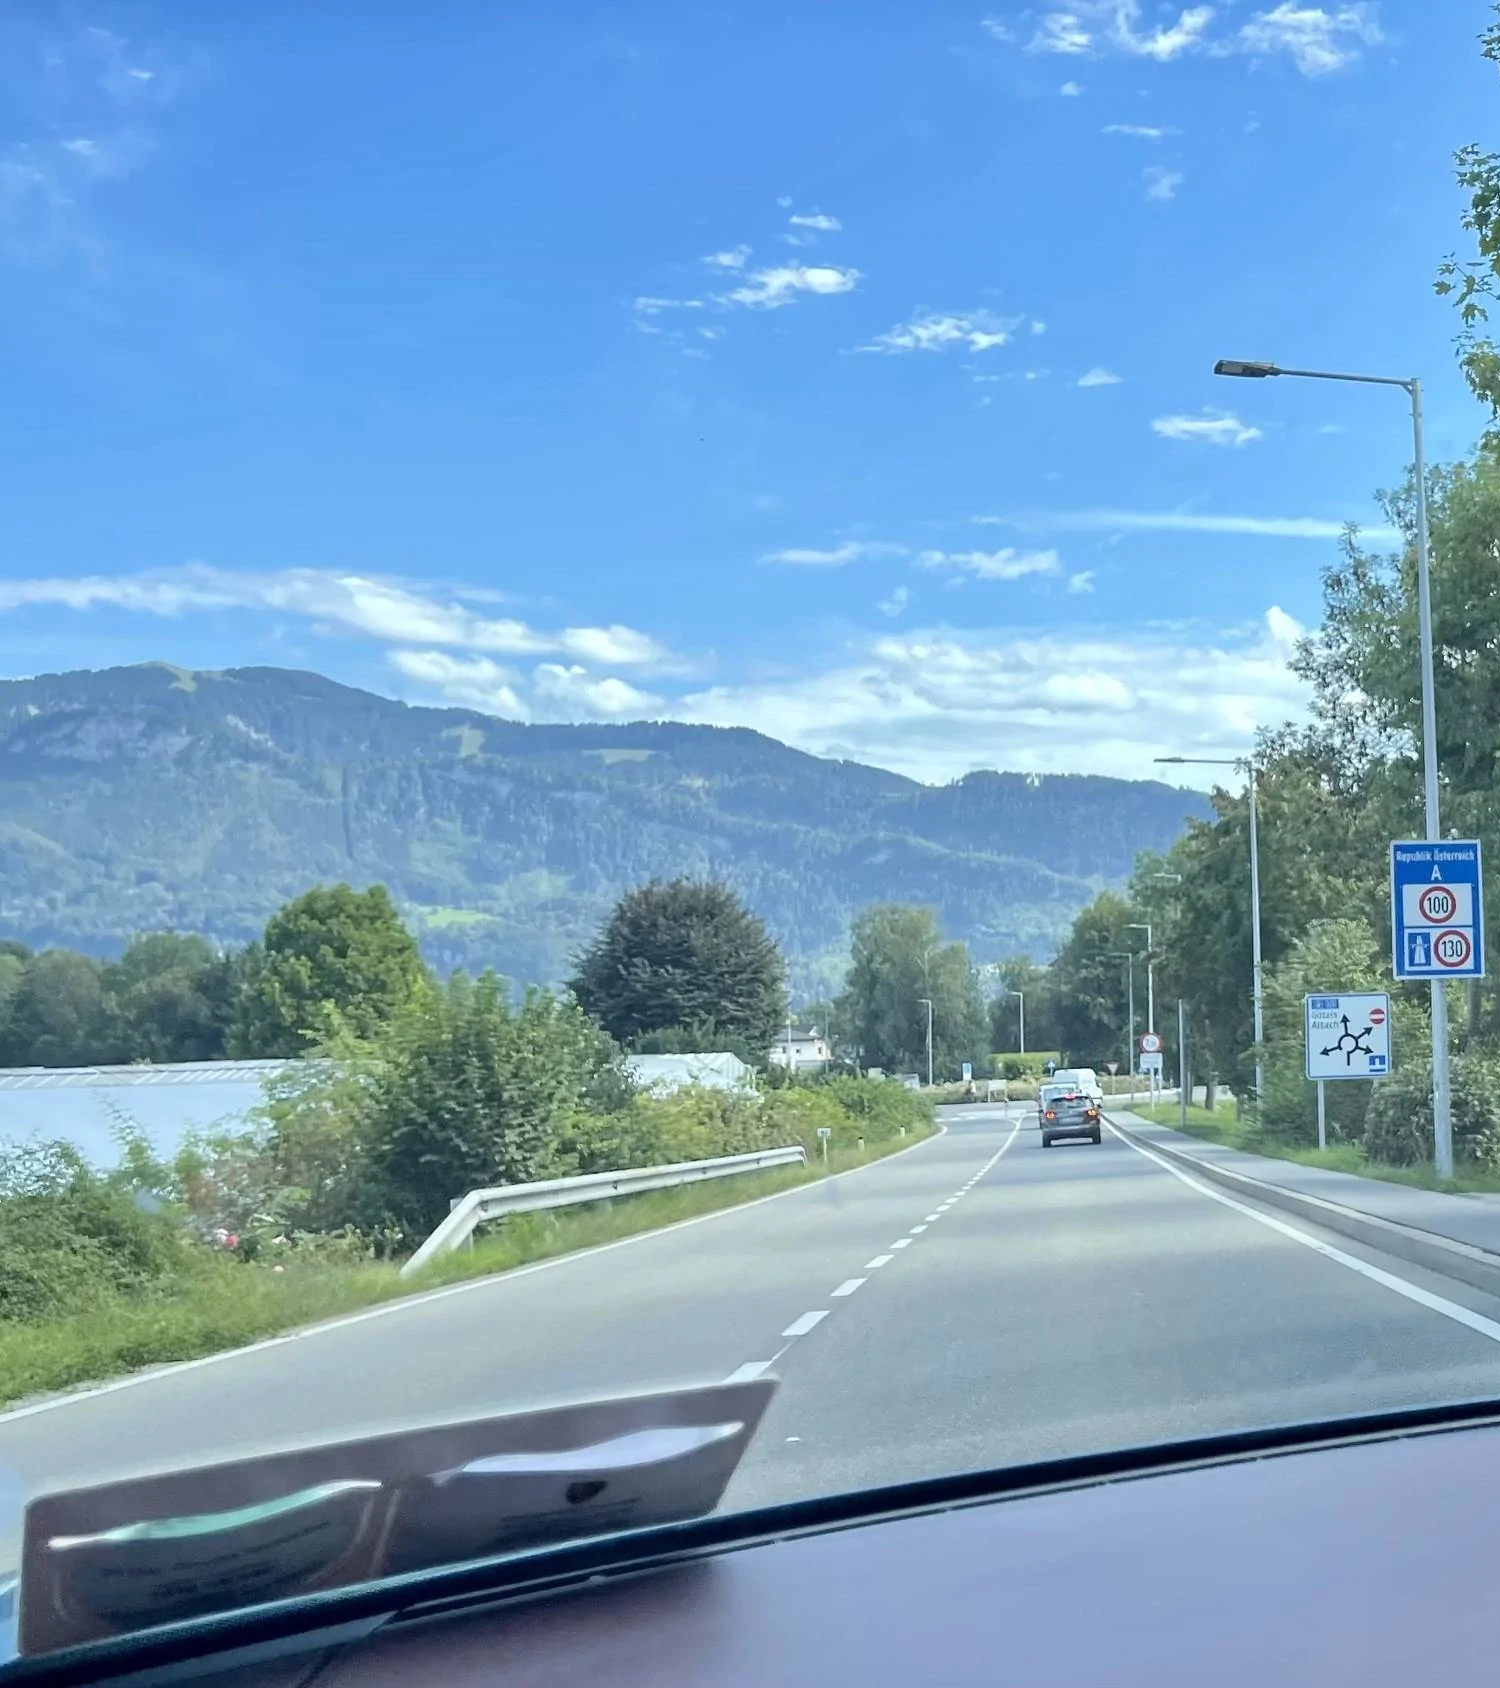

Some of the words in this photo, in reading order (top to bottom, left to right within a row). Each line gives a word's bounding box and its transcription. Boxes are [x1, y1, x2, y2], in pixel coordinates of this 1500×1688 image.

[1396, 851, 1432, 863] Republik
[1434, 848, 1474, 861] Österreich
[1431, 864, 1442, 881] A
[1427, 896, 1449, 914] 100
[1441, 940, 1463, 957] 130
